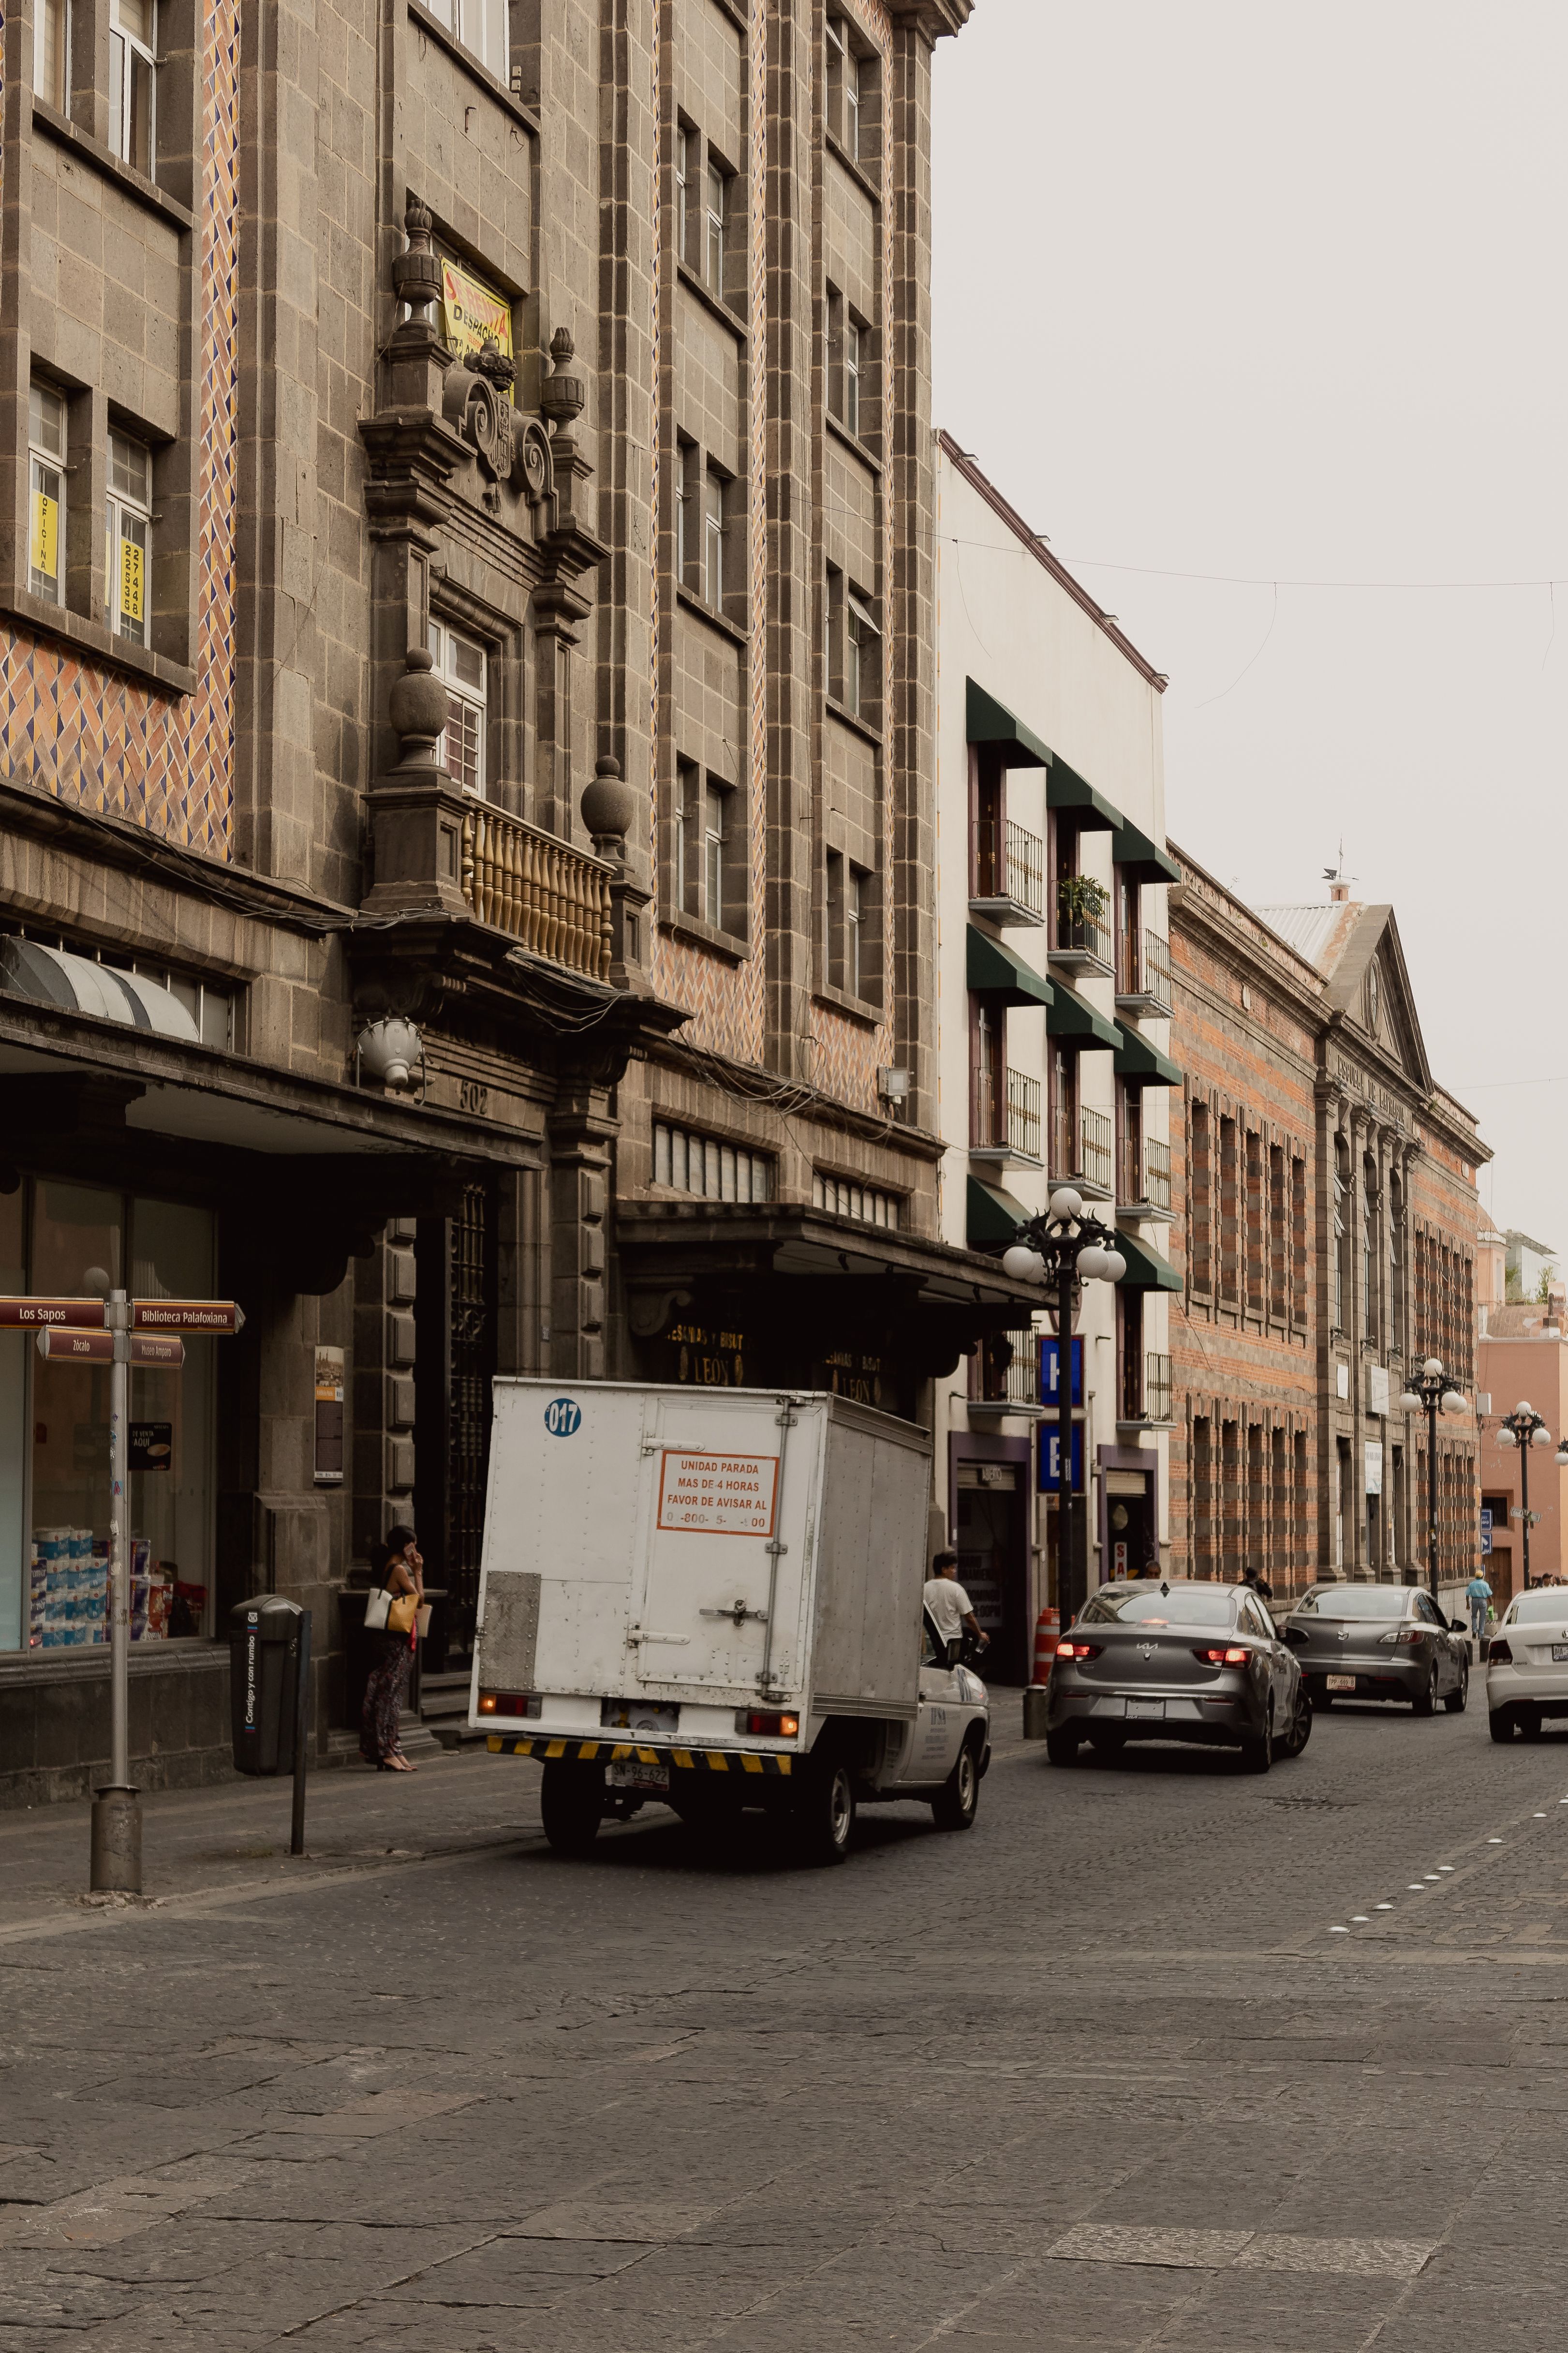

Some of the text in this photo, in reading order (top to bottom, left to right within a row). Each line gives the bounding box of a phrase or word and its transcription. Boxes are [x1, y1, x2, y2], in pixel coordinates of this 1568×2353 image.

[445, 270, 508, 339] SE RENTA
[453, 304, 500, 349] DESPACHO
[460, 1079, 488, 1114] 502
[19, 1308, 66, 1323] Los Sapos
[142, 1310, 227, 1324] Biblioteca Palafoxiana
[73, 1339, 90, 1352] Zócalo
[141, 1344, 172, 1359] Museo Amparo
[694, 1351, 729, 1386] LEÓN
[549, 1402, 578, 1432] 017
[680, 1460, 759, 1474] UNIDAD PARADA
[678, 1477, 759, 1492] MAS DE 4 HORAS
[667, 1494, 767, 1510] FAVOR DE AVISAR AL
[247, 1635, 255, 1665] rumbo
[245, 1689, 256, 1724] Contigo
